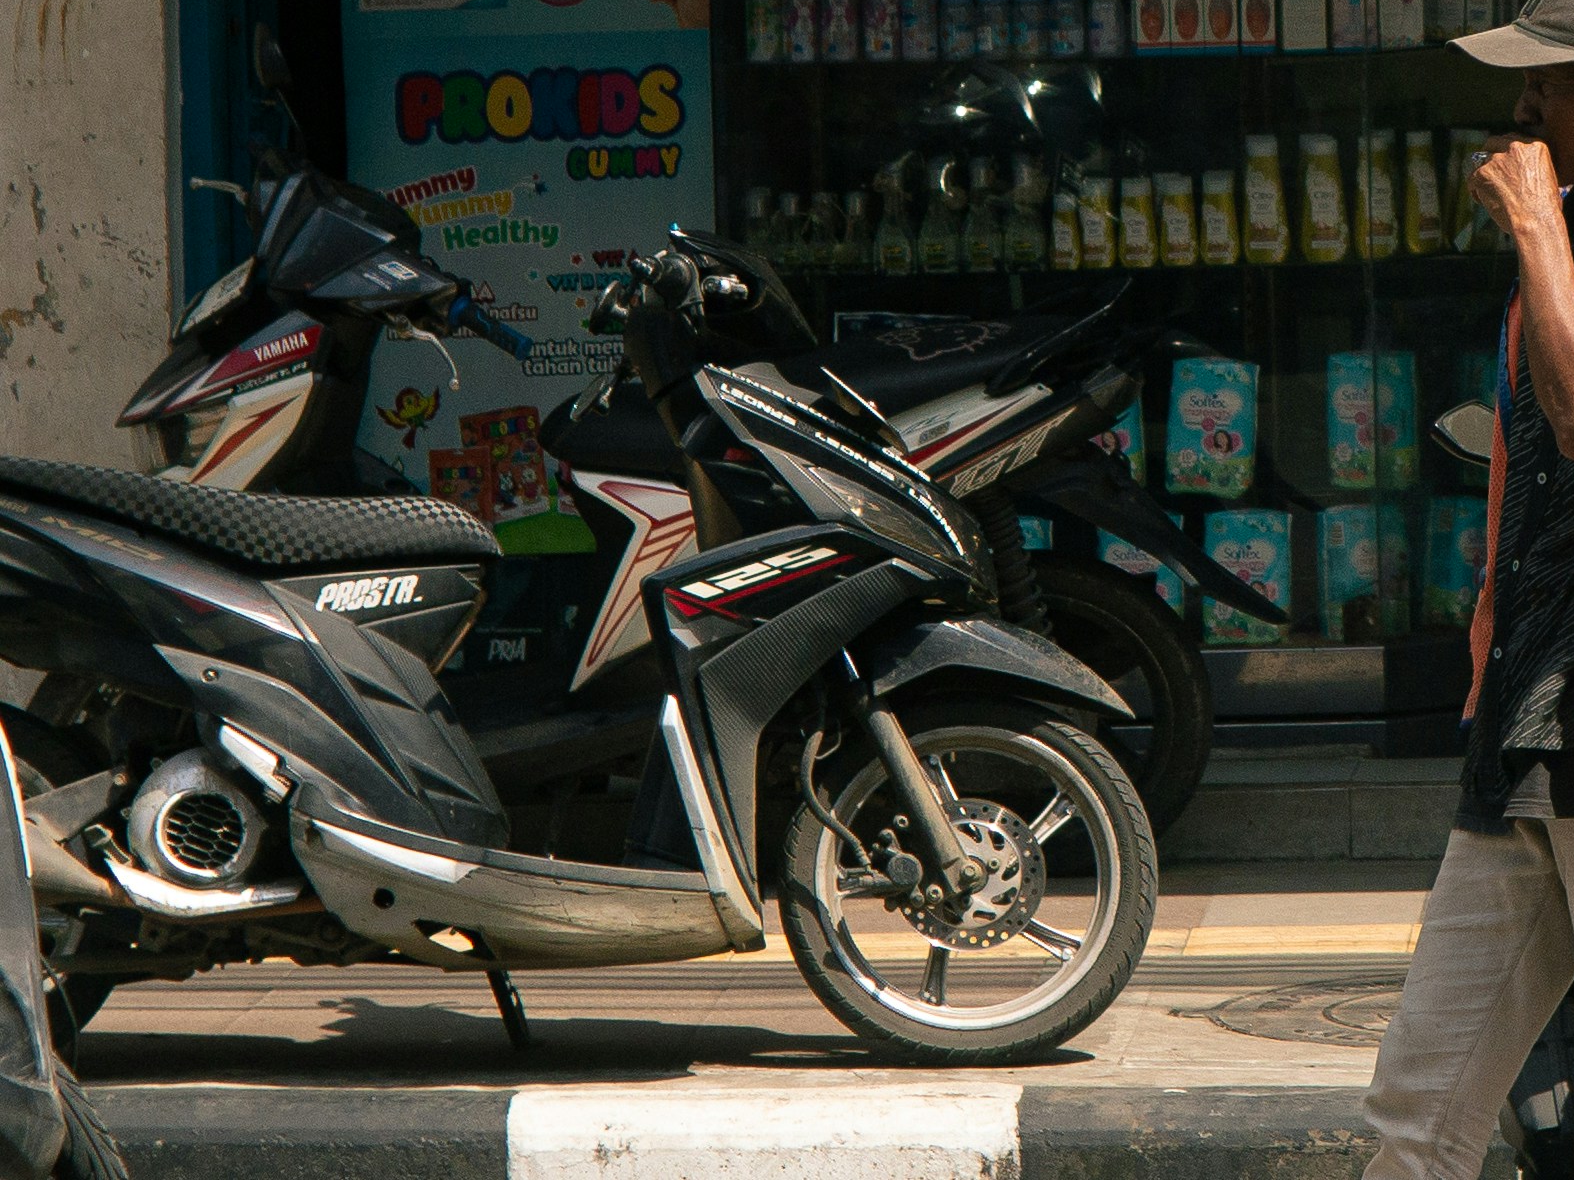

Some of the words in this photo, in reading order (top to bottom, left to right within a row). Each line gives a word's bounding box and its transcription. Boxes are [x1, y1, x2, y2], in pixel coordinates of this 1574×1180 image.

[396, 64, 683, 144] PROKIDS
[567, 145, 682, 180] GUMMY
[386, 166, 476, 207] ummy
[442, 218, 560, 251] Healthy
[489, 304, 537, 321] nafsu
[254, 332, 309, 362] YAMAHA
[524, 359, 582, 375] tahan
[1190, 394, 1226, 409] Softex
[1112, 550, 1149, 562] Softex
[1223, 546, 1260, 560] Softex
[680, 545, 839, 599] 125
